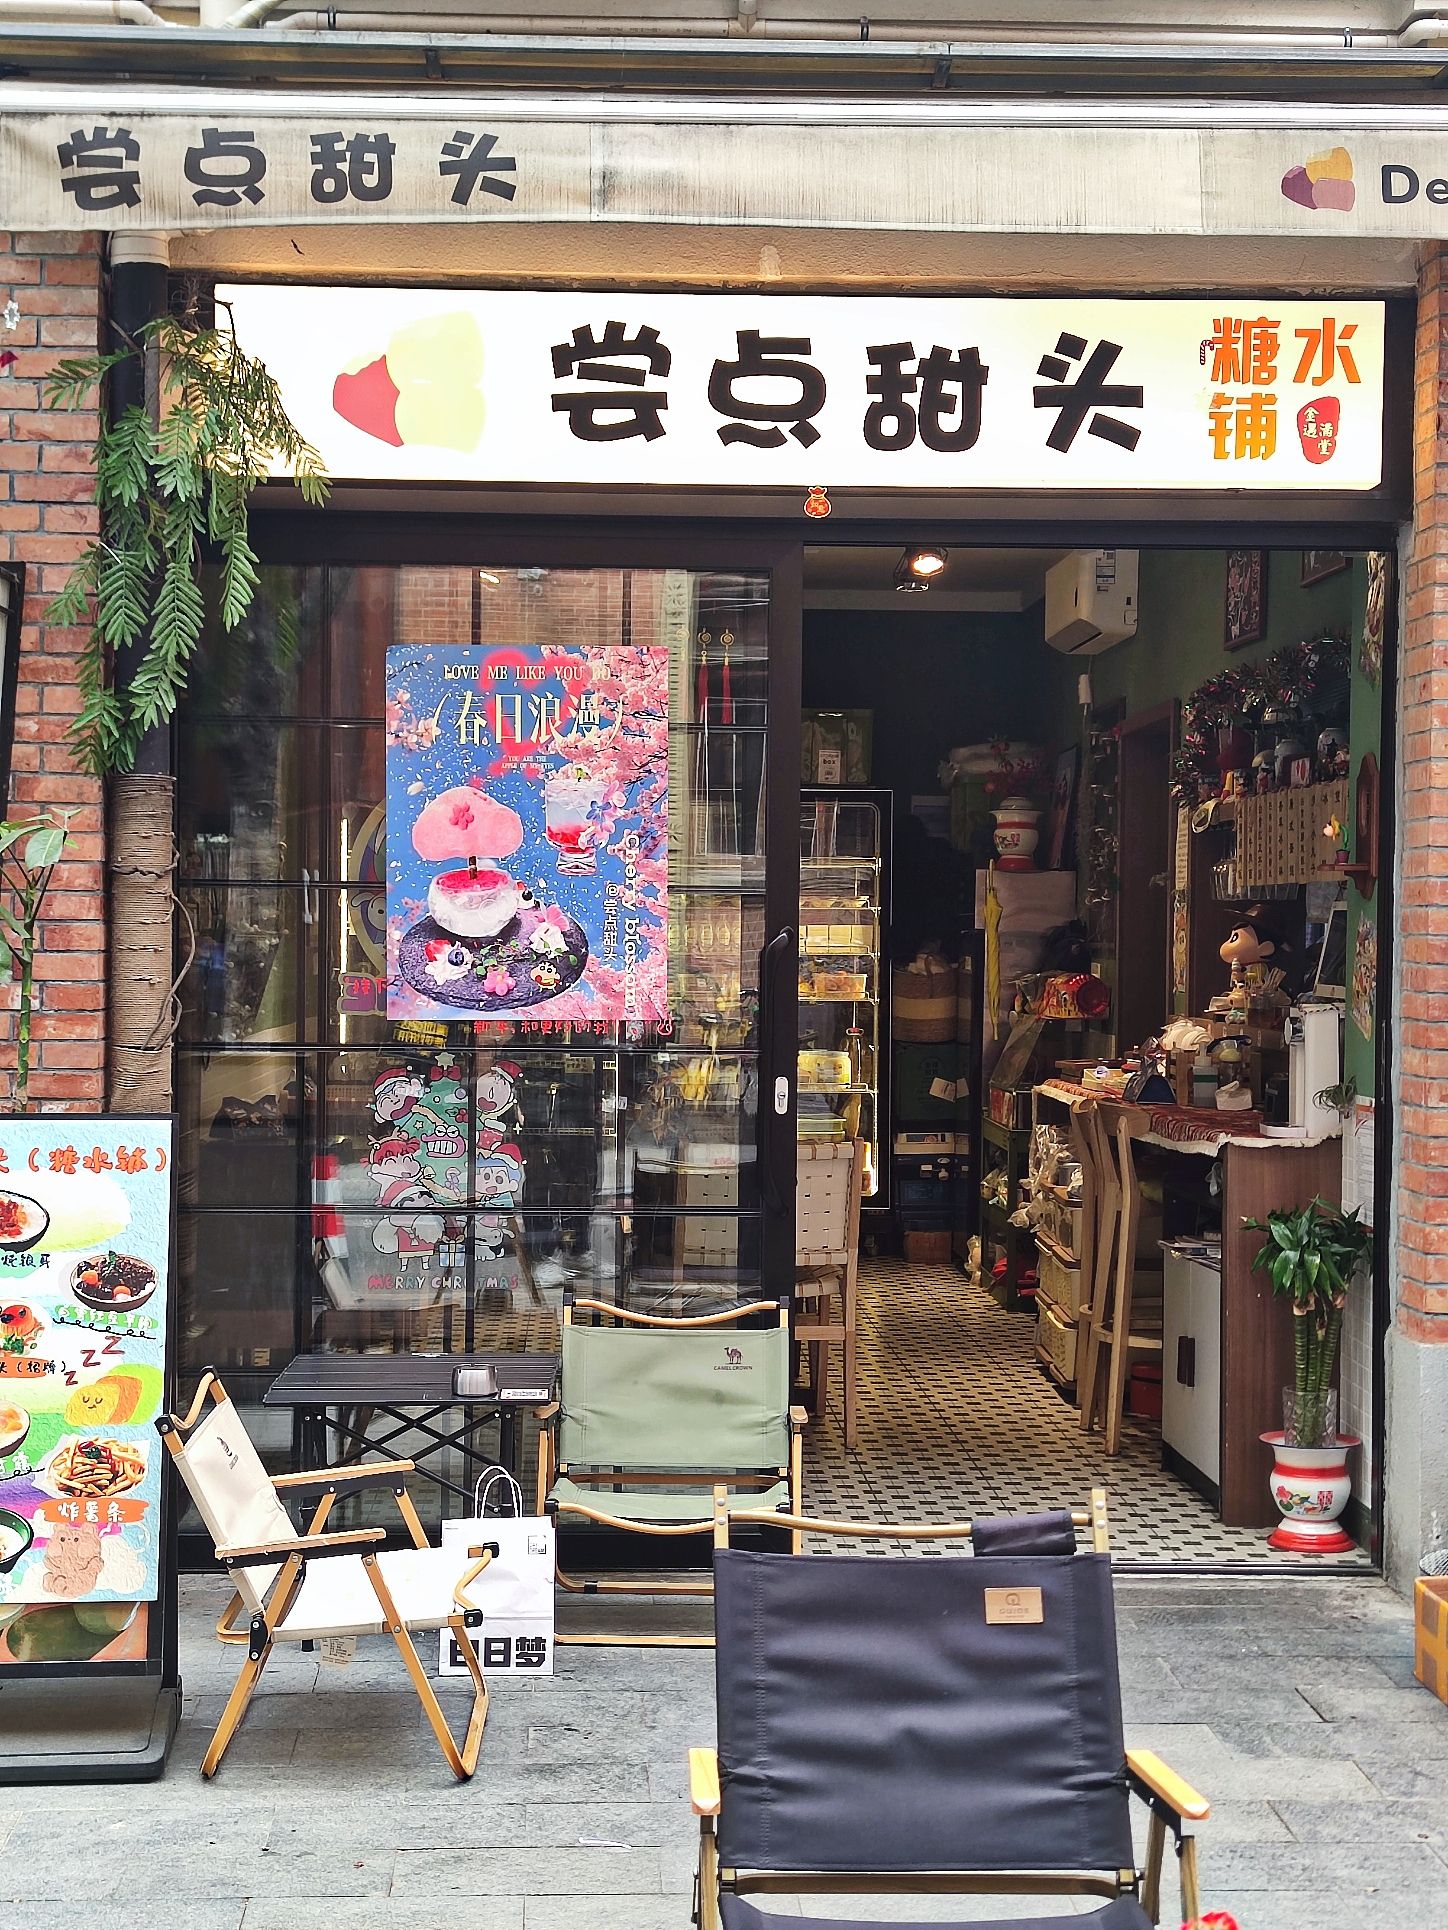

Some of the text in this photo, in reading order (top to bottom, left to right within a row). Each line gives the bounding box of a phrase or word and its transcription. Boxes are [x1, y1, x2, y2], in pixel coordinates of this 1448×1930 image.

[57, 127, 517, 211] 尝点甜头
[1382, 165, 1448, 204] De
[1211, 317, 1361, 386] 糖水
[551, 321, 1144, 453] 尝点甜头
[1208, 393, 1278, 460] 铺
[444, 665, 611, 680] LOVE ME LIKE YOU DO
[621, 835, 640, 1015] Cherry blossom
[368, 1275, 519, 1290] MERRY CHRTMAS
[57, 1501, 126, 1523] 炸薯条
